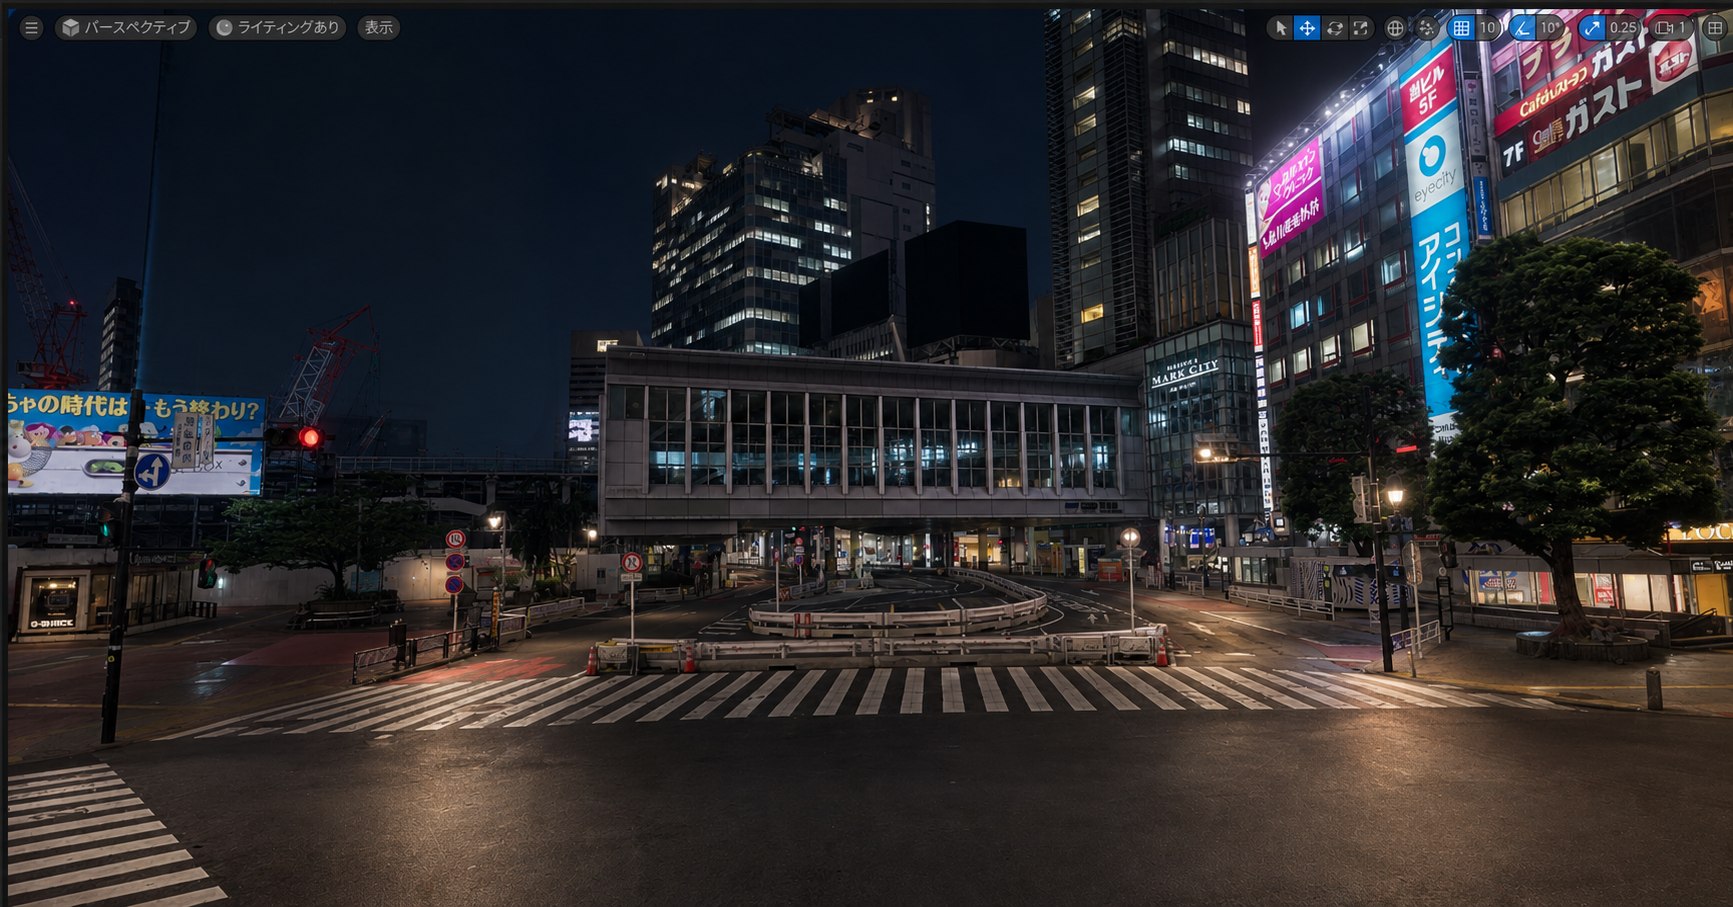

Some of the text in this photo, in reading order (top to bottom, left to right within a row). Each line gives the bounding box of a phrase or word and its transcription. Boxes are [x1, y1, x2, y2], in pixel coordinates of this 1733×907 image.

[1419, 88, 1437, 115] 5F
[1565, 76, 1643, 139] ガスト
[1503, 140, 1525, 168] 7F
[1414, 168, 1457, 203] eyecity
[1152, 369, 1185, 385] MARK
[1189, 360, 1218, 375] CITY
